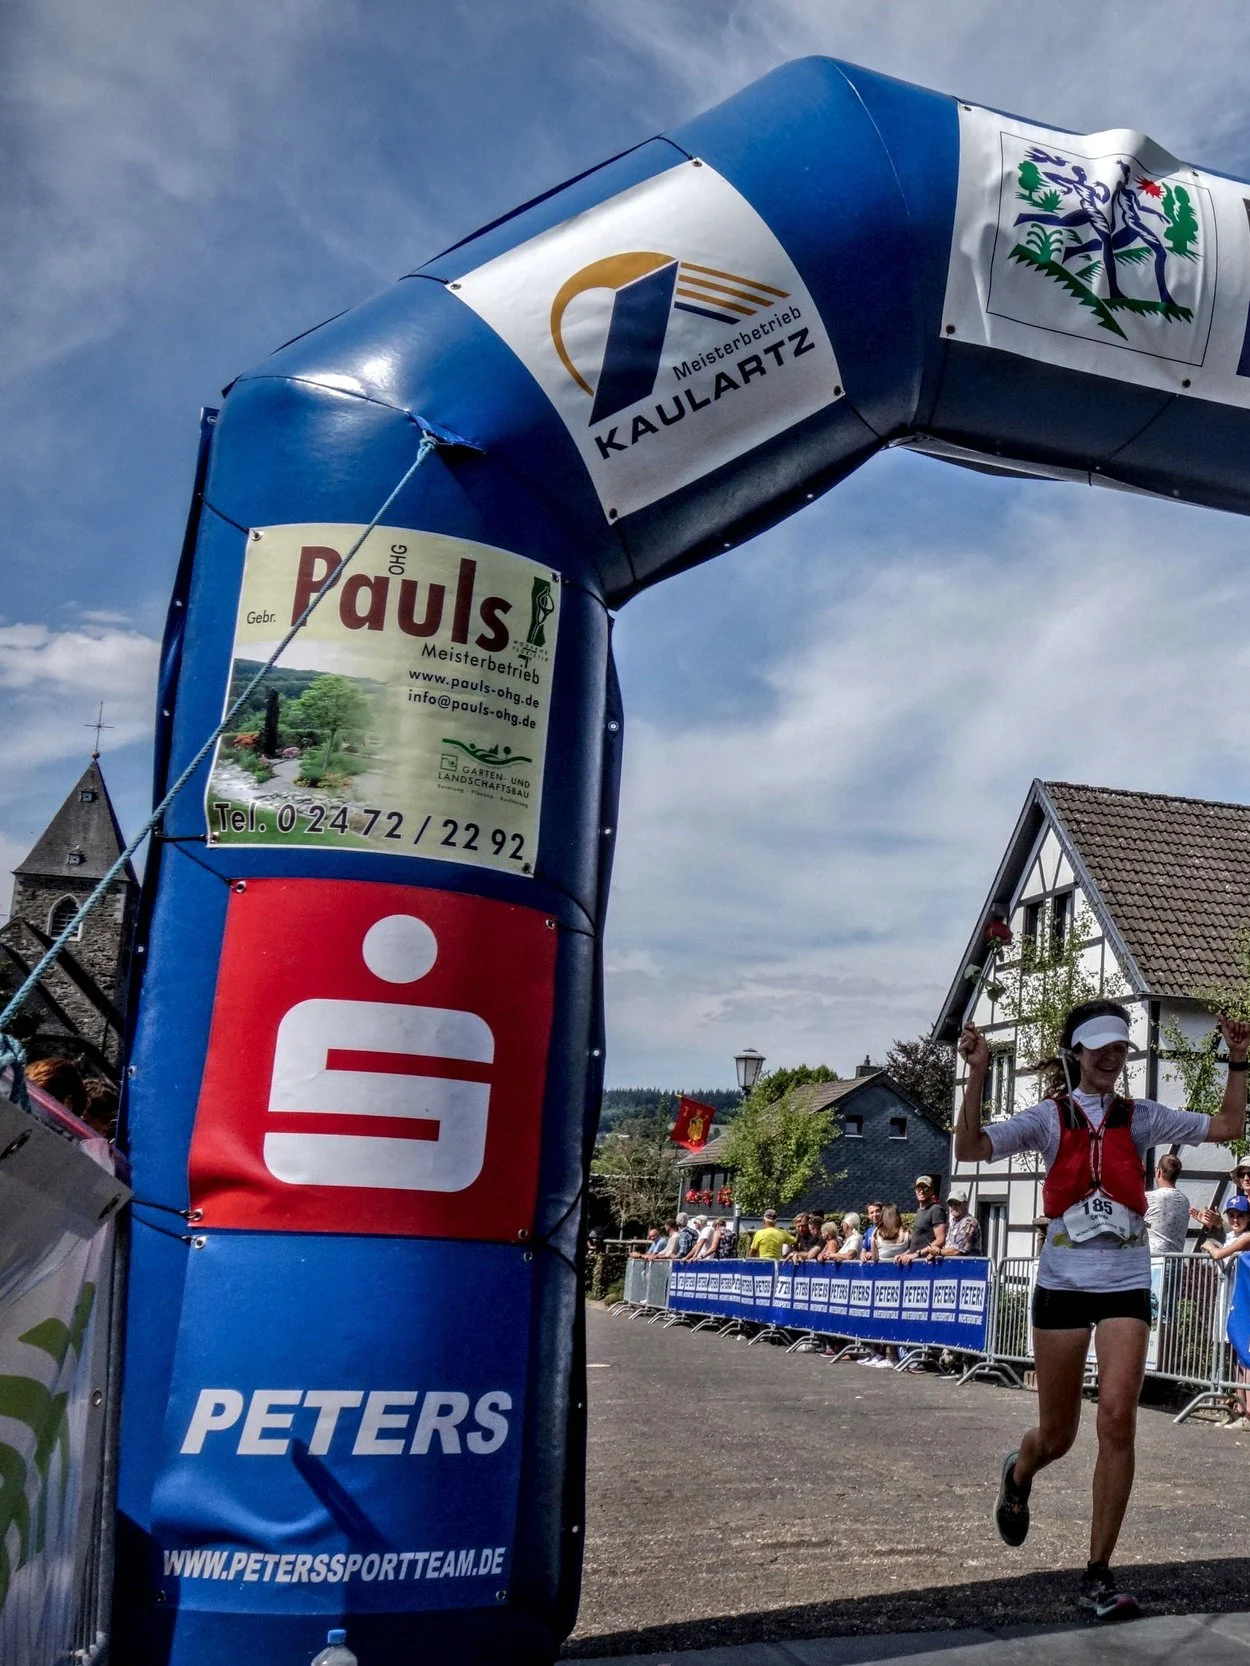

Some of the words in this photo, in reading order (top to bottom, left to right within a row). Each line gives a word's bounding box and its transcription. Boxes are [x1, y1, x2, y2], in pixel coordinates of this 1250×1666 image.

[673, 306, 801, 380] Meisterbetrieb
[594, 327, 815, 460] KAULARTZ
[388, 544, 407, 575] OHG
[246, 611, 276, 625] Gebr.
[291, 546, 513, 652] Pauls
[421, 643, 540, 685] Meisterbetrieb
[408, 670, 540, 708] www.pauls-ohg.de
[408, 689, 536, 729] info@pauls-ohg.de
[438, 771, 529, 799] LANDSCHAFTSBAU
[462, 765, 506, 781] GARTEN-
[511, 777, 530, 789] UND
[213, 803, 266, 833] Tel.
[277, 804, 297, 832] 0
[1082, 1199, 1112, 1215] 185
[903, 1285, 928, 1304] PETERS
[179, 1390, 512, 1455] PETERS
[163, 1547, 505, 1583] WWW.PETERSSPORTTEAM.DE
